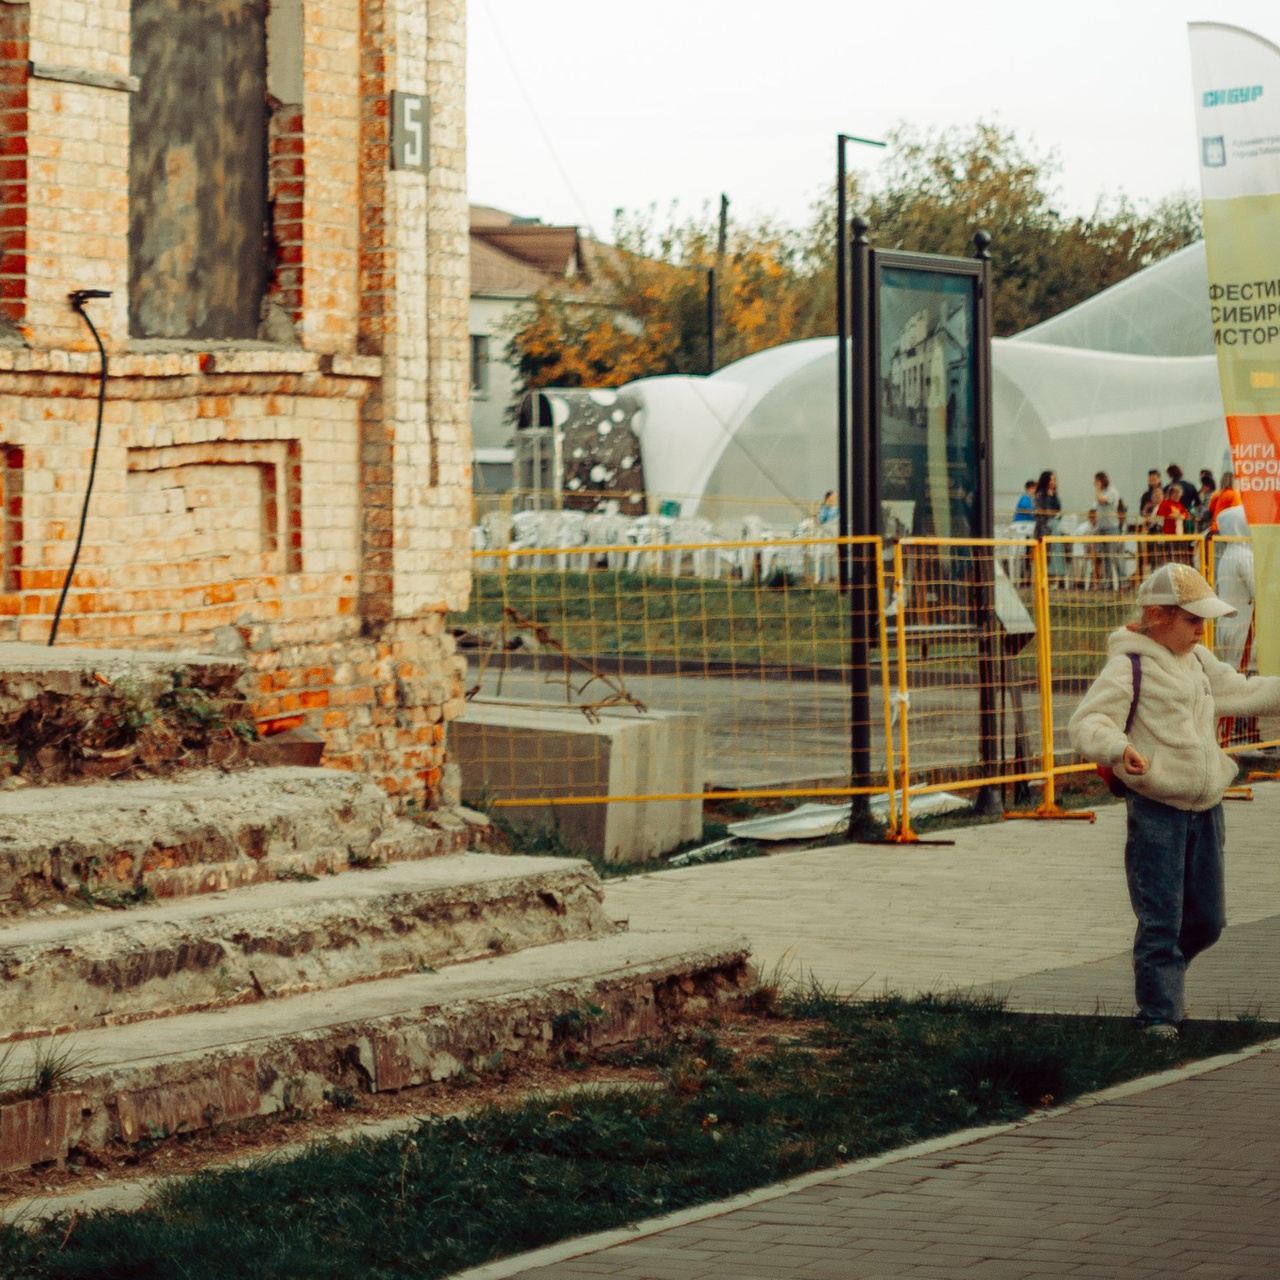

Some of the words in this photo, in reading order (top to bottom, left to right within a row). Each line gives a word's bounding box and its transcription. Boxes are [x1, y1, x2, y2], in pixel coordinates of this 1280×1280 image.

[403, 97, 422, 167] 5
[1211, 303, 1280, 324] СИБИР
[1214, 325, 1280, 346] ИСТОР
[1235, 459, 1280, 475] ГОРО
